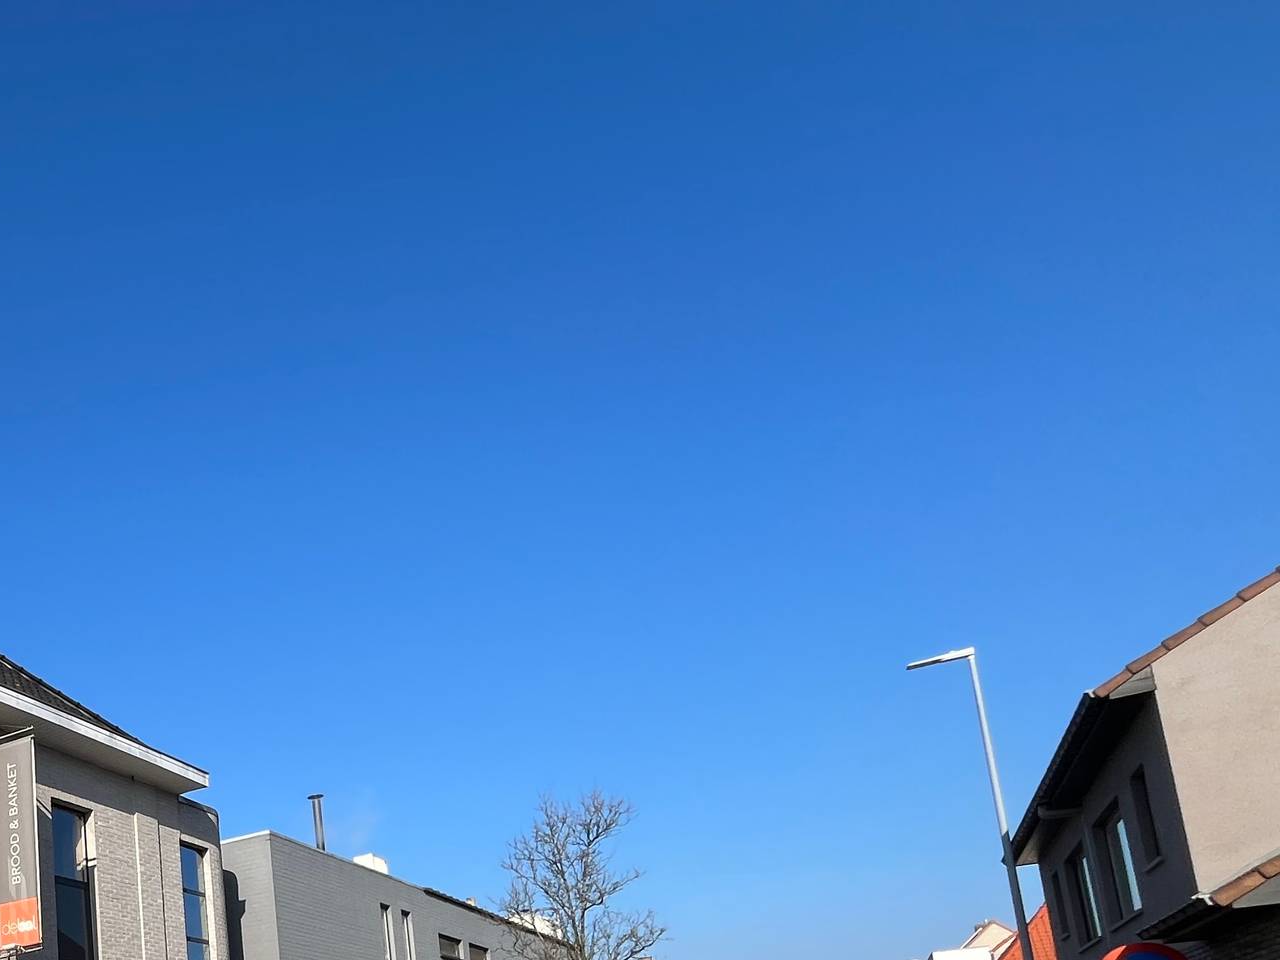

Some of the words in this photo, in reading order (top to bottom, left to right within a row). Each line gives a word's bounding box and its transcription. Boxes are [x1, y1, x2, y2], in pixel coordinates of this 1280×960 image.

[7, 763, 18, 816] BANKET
[9, 820, 19, 829] &
[10, 833, 21, 885] BROOD
